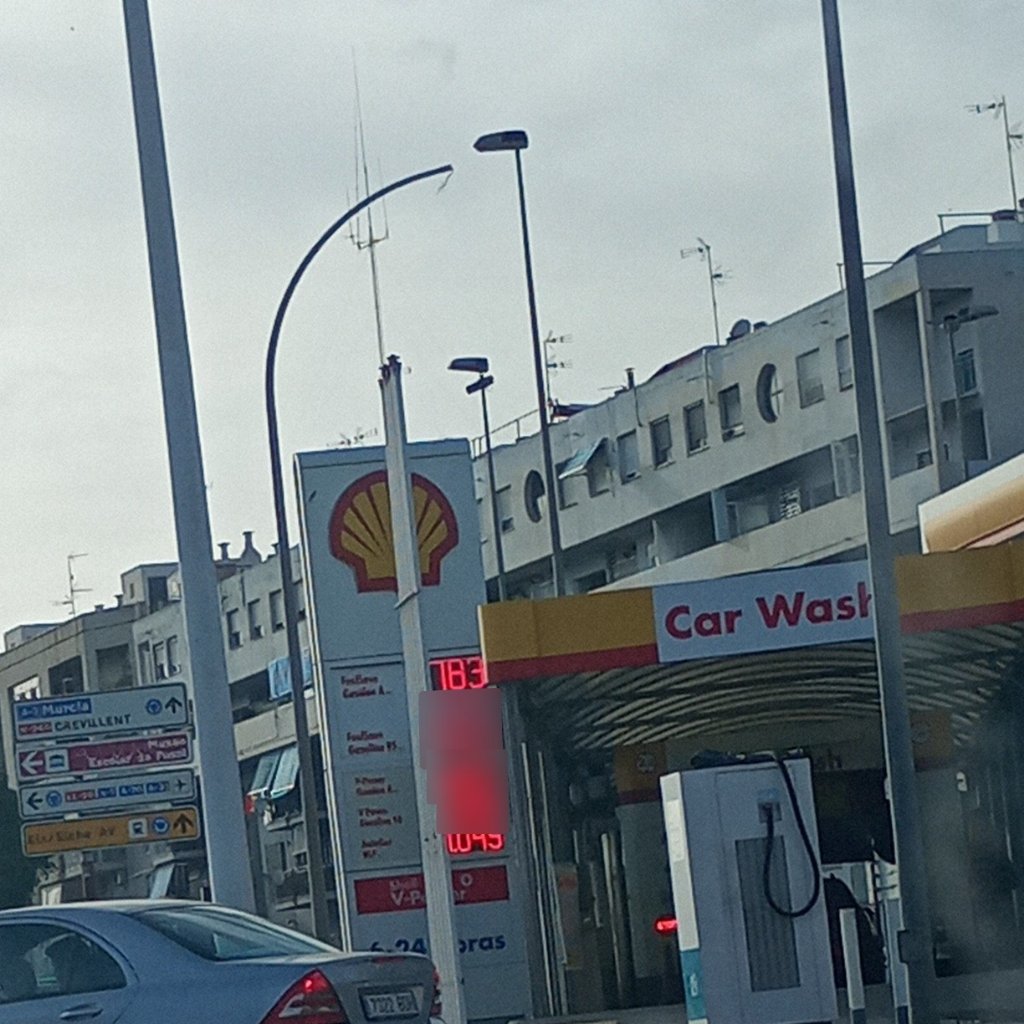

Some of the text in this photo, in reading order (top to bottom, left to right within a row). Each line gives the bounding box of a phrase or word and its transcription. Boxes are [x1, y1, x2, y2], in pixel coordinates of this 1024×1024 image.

[665, 581, 873, 640] Car Wash
[42, 701, 90, 715] Murcia
[55, 714, 131, 731] CREVILLENT
[458, 935, 506, 953] oras
